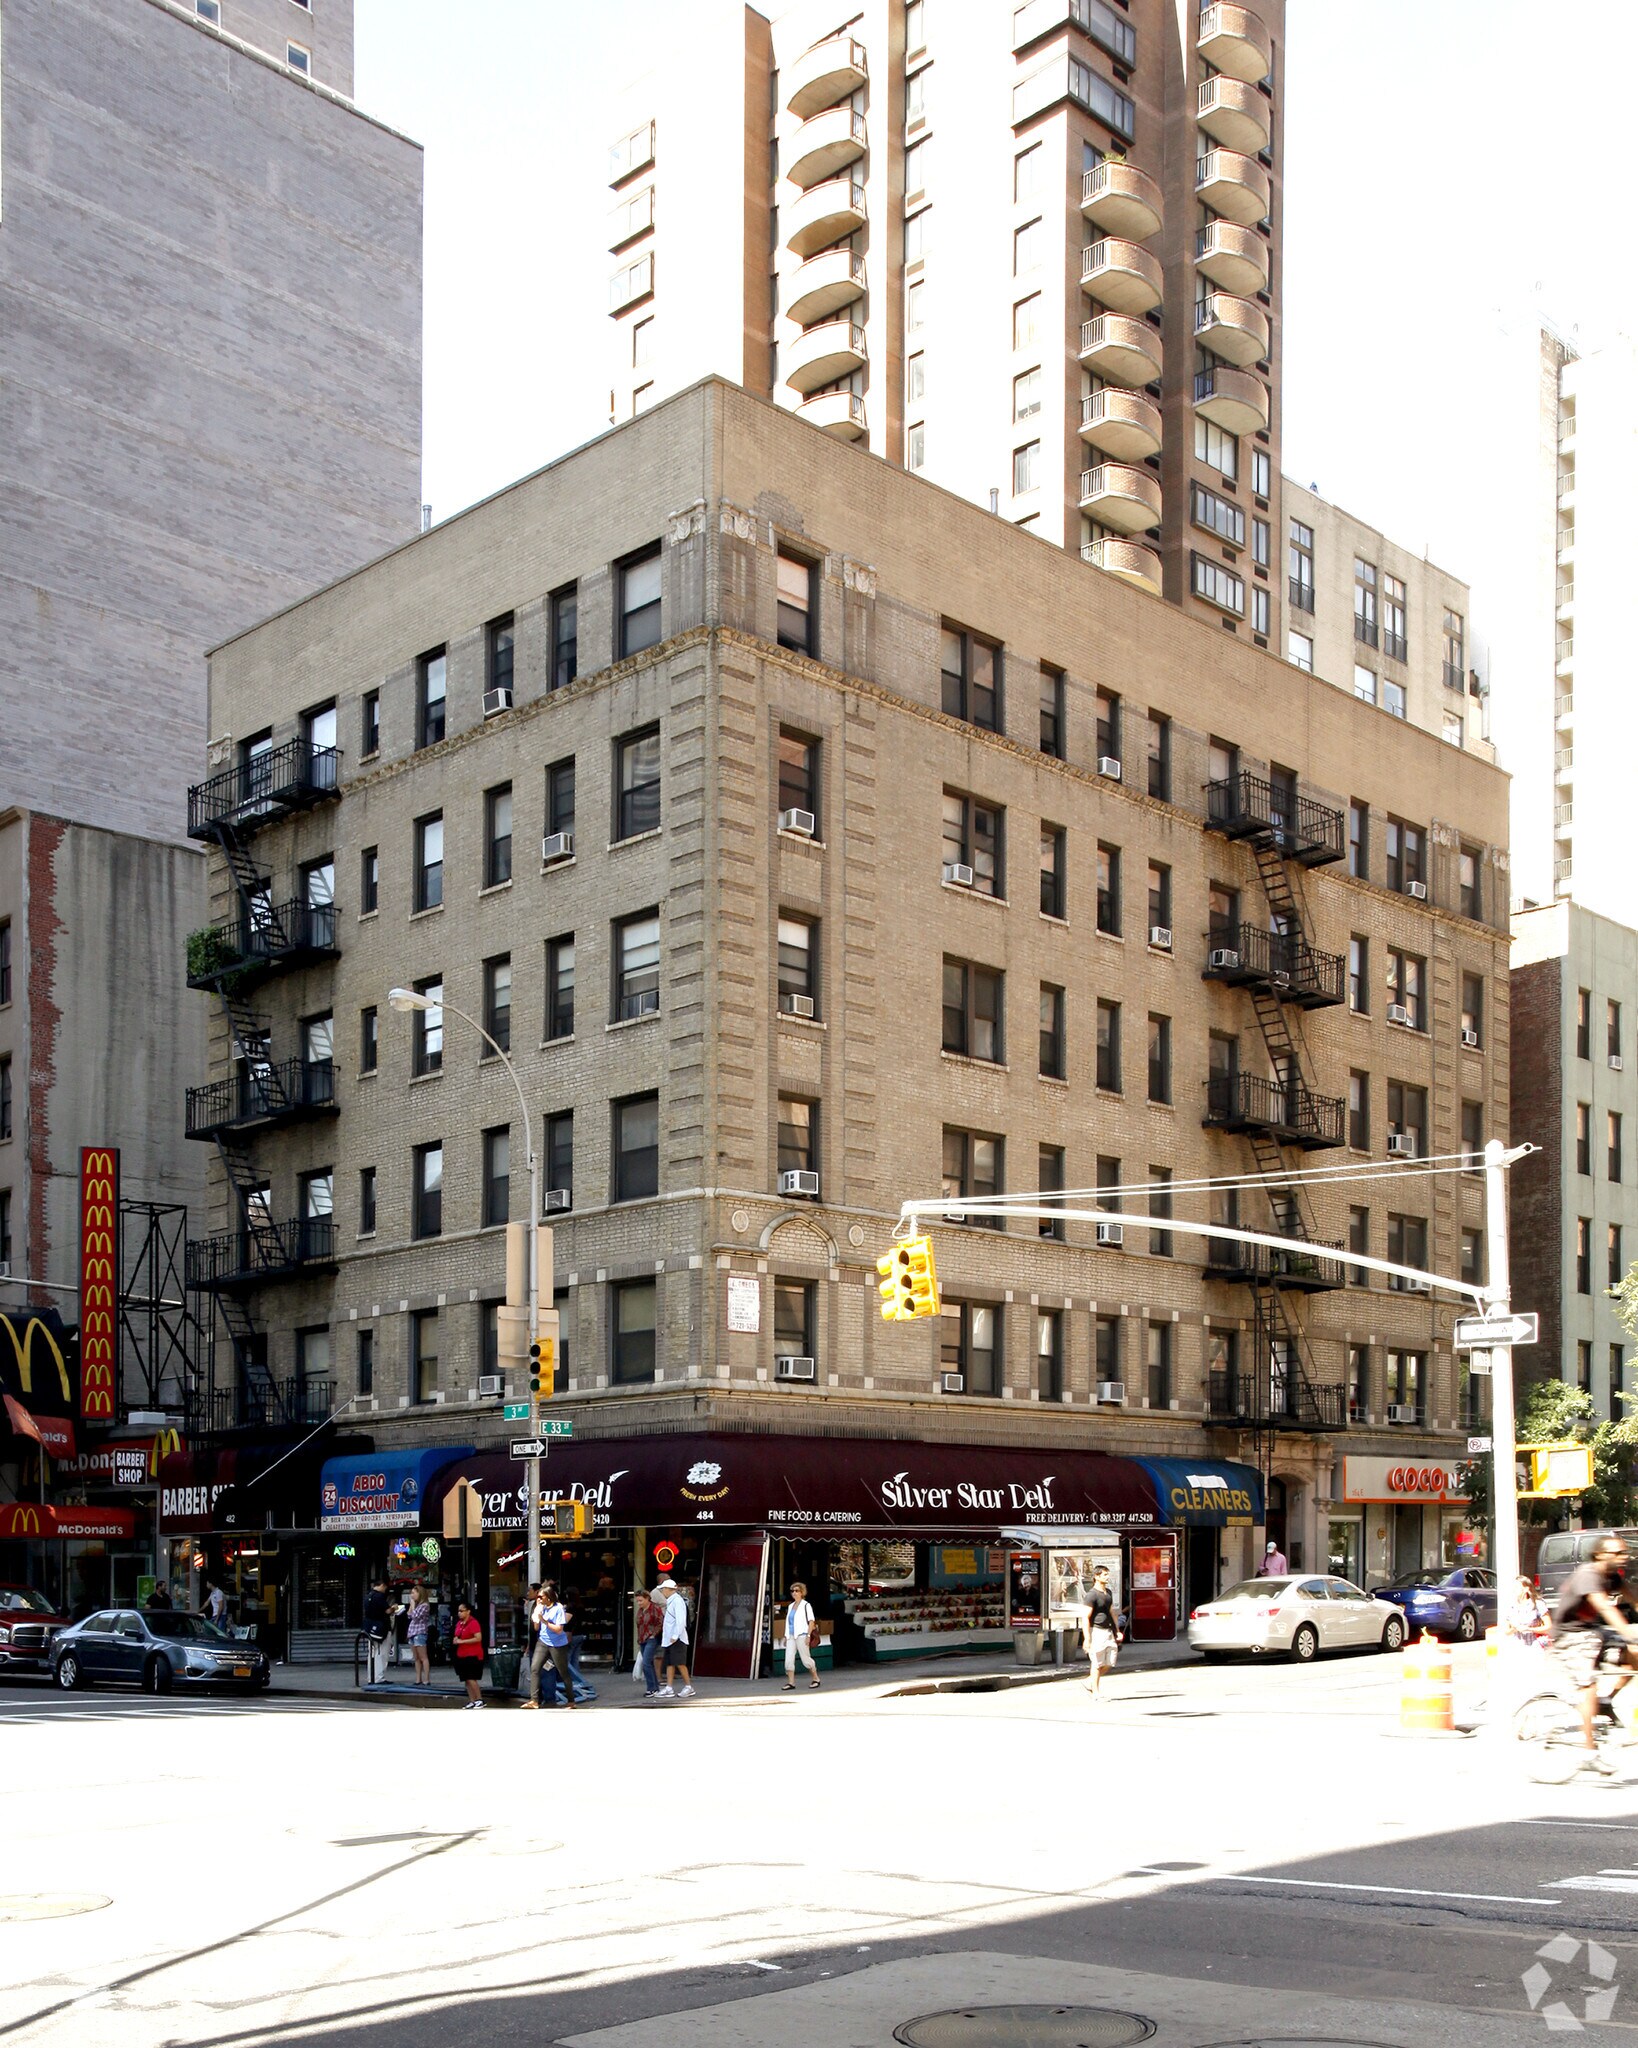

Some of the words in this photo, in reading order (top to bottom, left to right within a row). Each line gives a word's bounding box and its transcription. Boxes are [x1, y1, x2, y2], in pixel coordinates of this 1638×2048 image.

[511, 1407, 517, 1418] 3
[542, 1422, 547, 1433] E
[550, 1423, 561, 1434] 33
[515, 1445, 526, 1453] ONE
[530, 1444, 542, 1452] WAY
[116, 1452, 145, 1467] BARBER
[118, 1468, 143, 1483] SHOP
[1390, 1467, 1445, 1493] COCO
[352, 1473, 386, 1492] ABDO
[324, 1492, 336, 1501] 24
[679, 1487, 697, 1500] FRESH
[698, 1493, 717, 1502] EVERY
[881, 1474, 952, 1508] Silver
[957, 1482, 1004, 1509] Star
[1008, 1478, 1055, 1509] Deli
[162, 1486, 208, 1517] BARBER
[338, 1493, 400, 1514] DISCOUNT
[1170, 1488, 1252, 1511] CLEANERS
[225, 1514, 236, 1523] 482
[696, 1510, 714, 1520] 484
[768, 1510, 786, 1521] FINE
[787, 1510, 813, 1521] FOOD
[814, 1511, 822, 1521] &
[822, 1511, 862, 1522] CATERING
[1026, 1513, 1047, 1523] FREE
[57, 1524, 124, 1534] McDonald's
[333, 1546, 356, 1556] ATM
